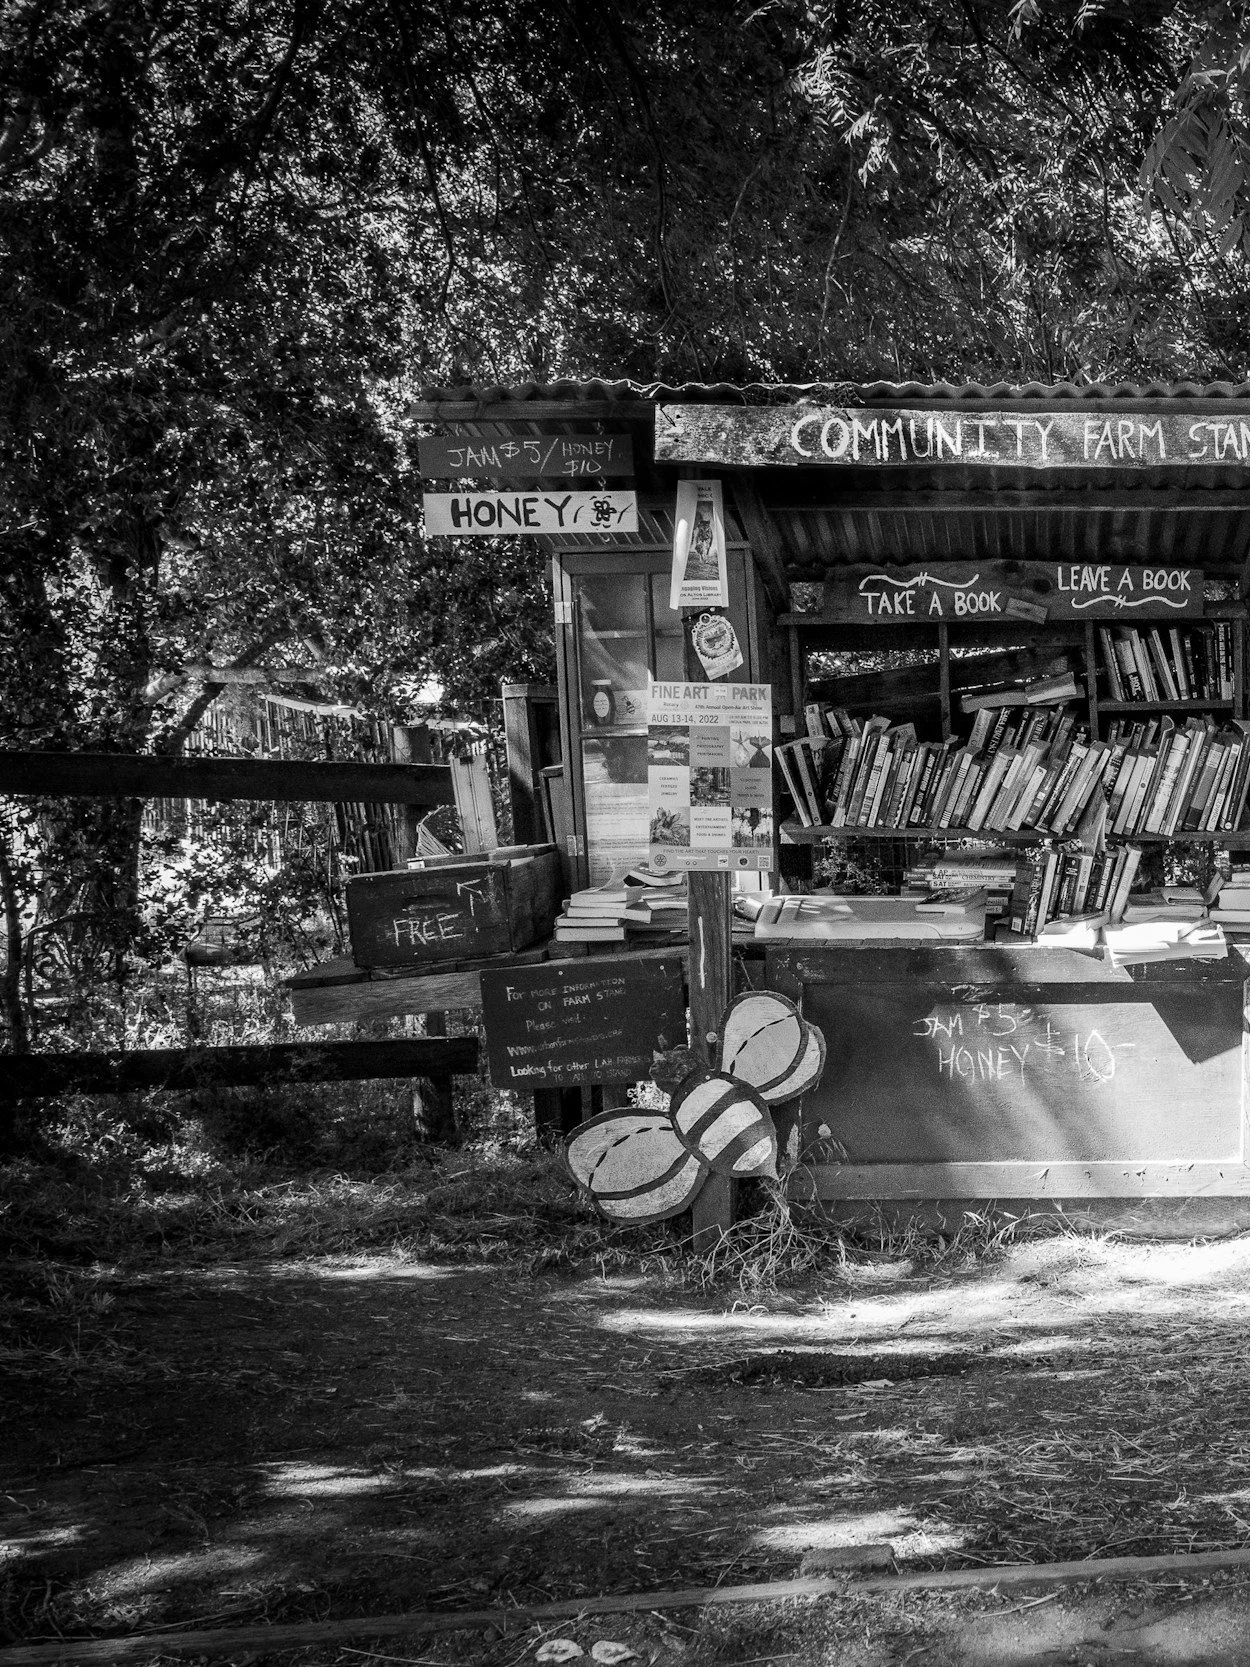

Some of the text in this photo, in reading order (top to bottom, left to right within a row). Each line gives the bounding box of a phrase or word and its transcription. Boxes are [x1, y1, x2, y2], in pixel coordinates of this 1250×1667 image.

[791, 415, 1054, 461] COMMUNITY
[1083, 420, 1166, 460] FARM
[447, 446, 501, 468] JAM
[562, 438, 614, 461] HONEY
[561, 459, 602, 477] $10
[451, 495, 572, 528] HONEY
[1057, 565, 1191, 592] LEAVE A BOOK
[859, 590, 1002, 616] TAKE A BOOK
[652, 685, 767, 700] FINE ART PARK
[652, 714, 668, 723] AUG
[699, 715, 719, 723] 2022
[393, 913, 463, 946] FREE
[531, 987, 557, 998] MORE
[538, 1001, 552, 1011] ON
[563, 994, 591, 1006] FARM
[912, 1013, 963, 1038] JAM
[510, 1064, 547, 1079] Looking
[547, 1060, 563, 1072] for
[566, 1061, 590, 1072] other
[939, 1044, 1030, 1085] HONEY
